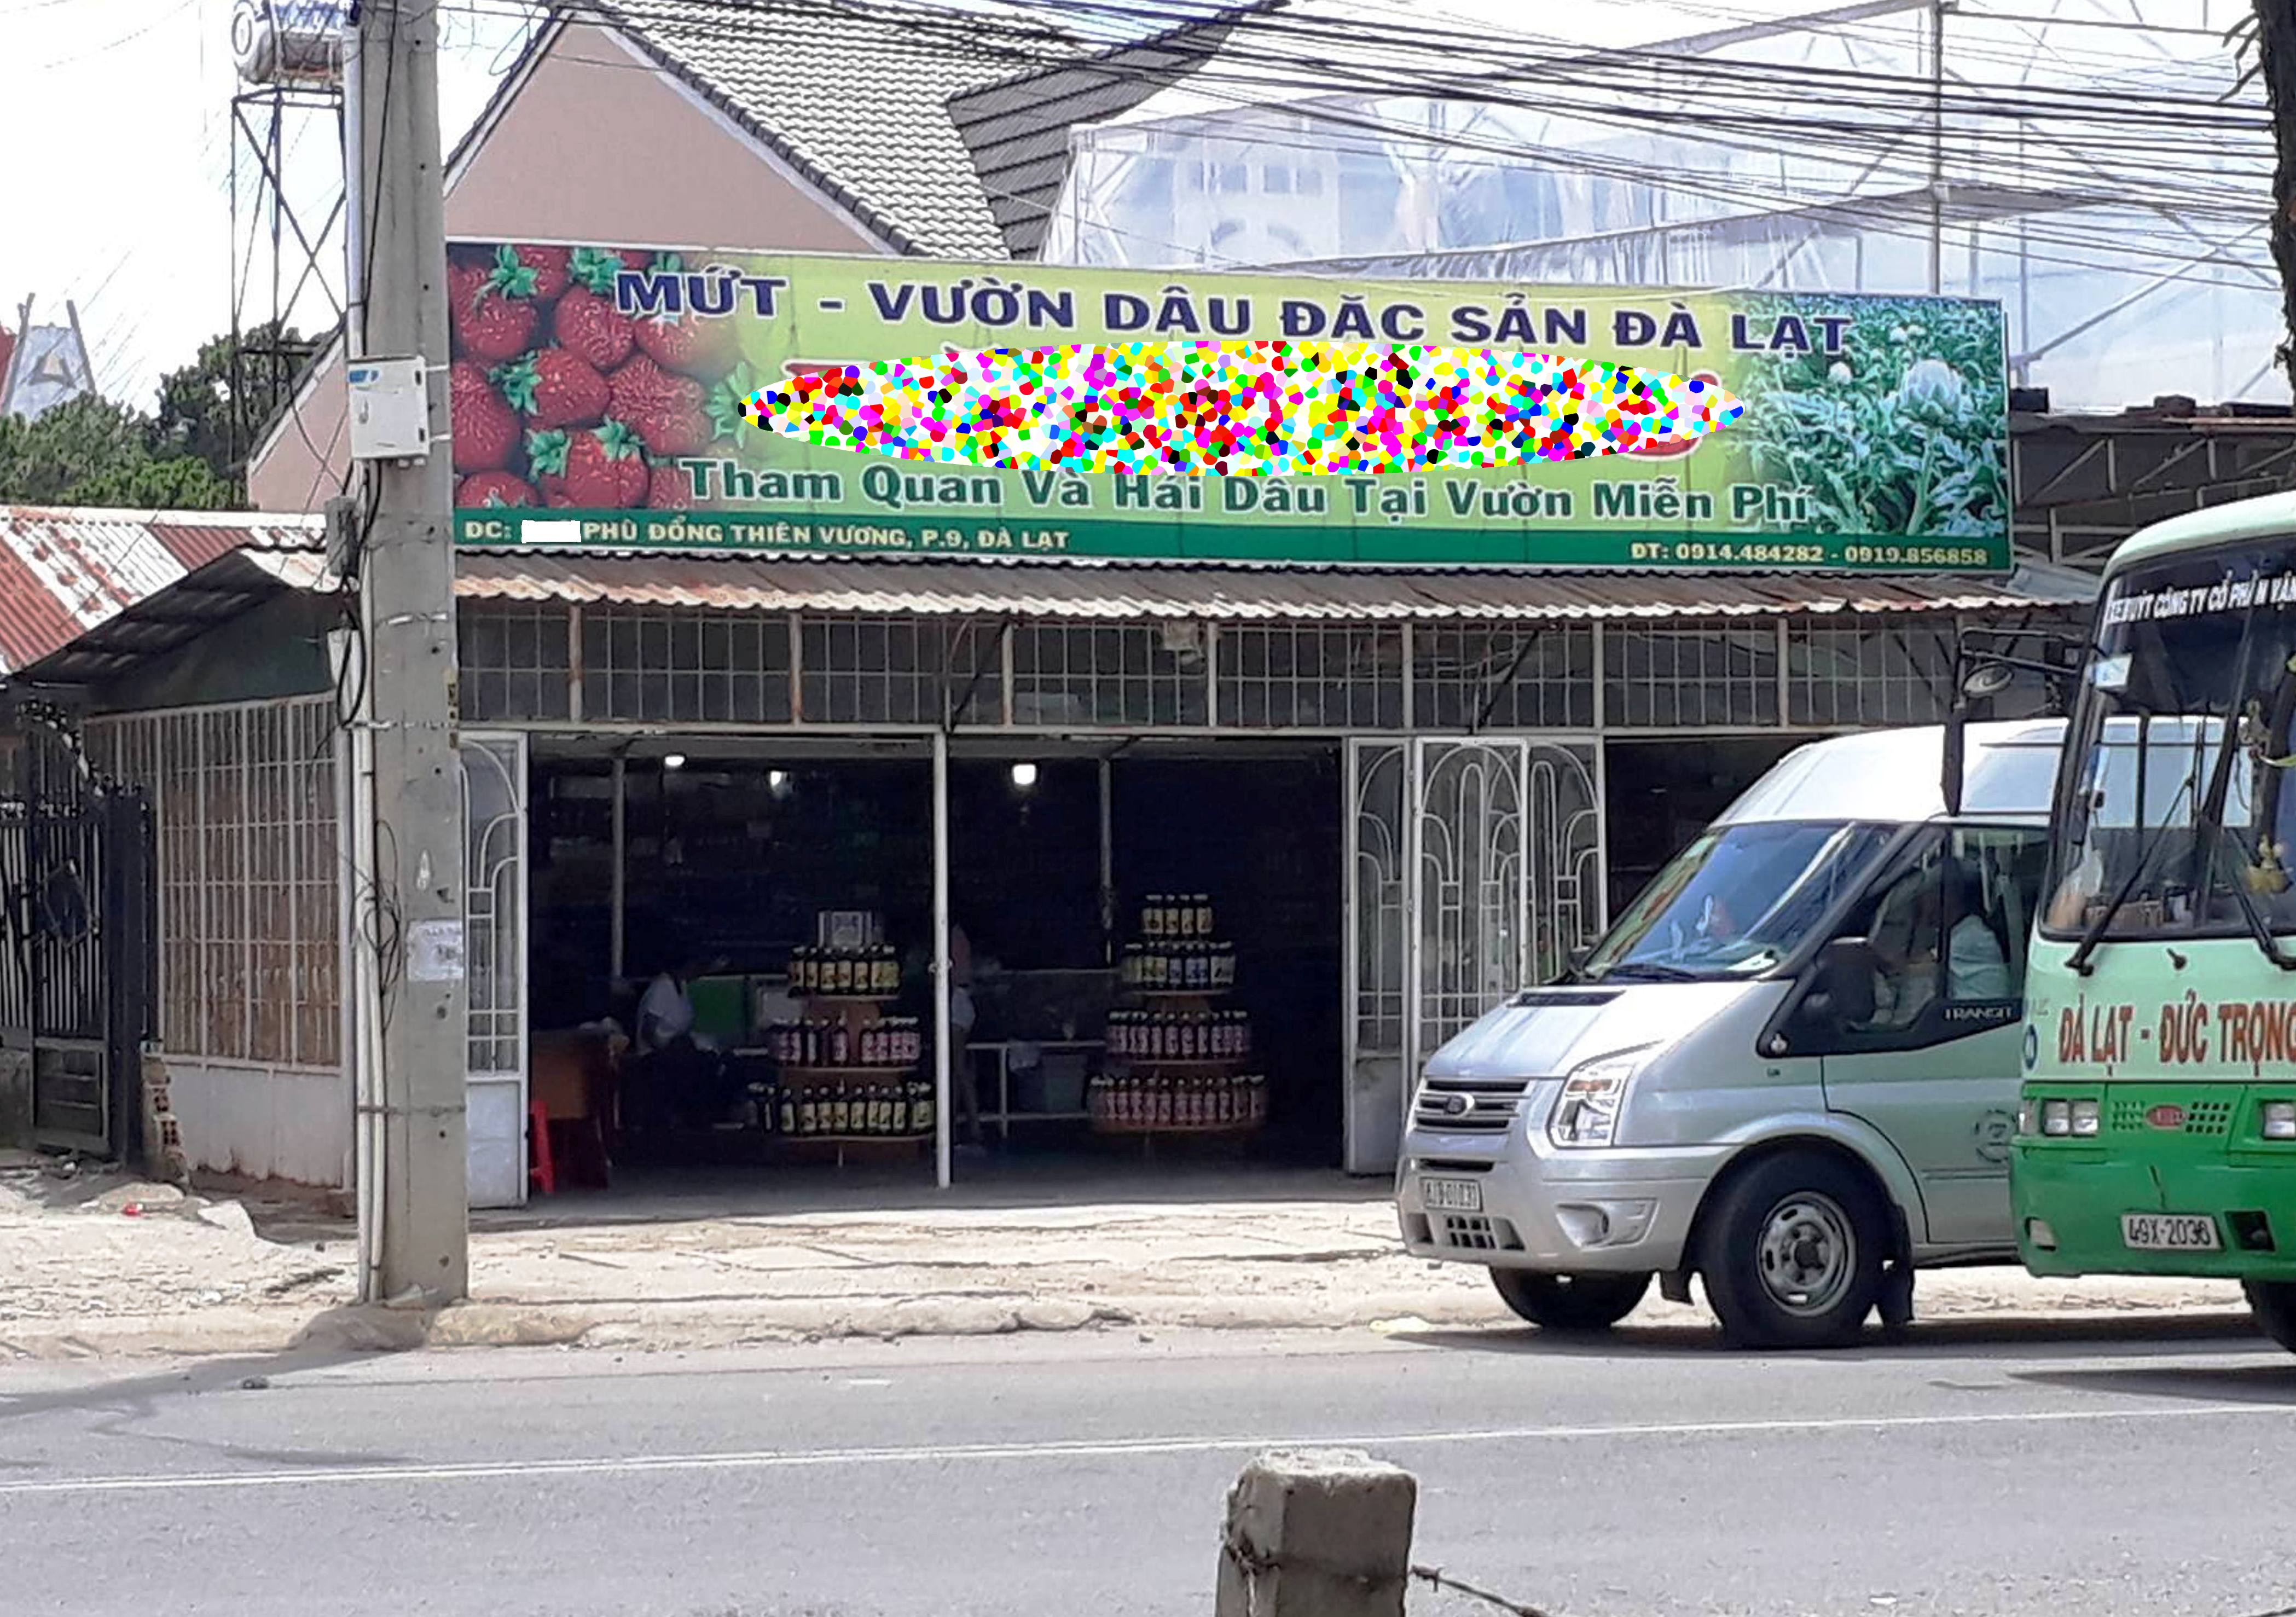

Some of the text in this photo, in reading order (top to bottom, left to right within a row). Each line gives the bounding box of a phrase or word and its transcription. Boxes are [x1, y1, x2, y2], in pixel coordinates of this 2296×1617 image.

[616, 265, 787, 317] MỨT
[868, 280, 1074, 328] VƯỜN
[1103, 286, 1251, 335] DÂU
[1450, 292, 1587, 344] SẢN
[1611, 300, 1703, 348] ĐÀ
[1732, 314, 1853, 359] LẠT
[681, 460, 1807, 521] Tham Quan Và Hái Dâu Tại Vườn Miễn Phí
[583, 519, 639, 541] PHÙ
[729, 521, 811, 544] THIÊN
[1021, 531, 1070, 552] LẠT
[1675, 543, 1824, 563] 0914.484282
[1844, 545, 1988, 565] 0919.856858
